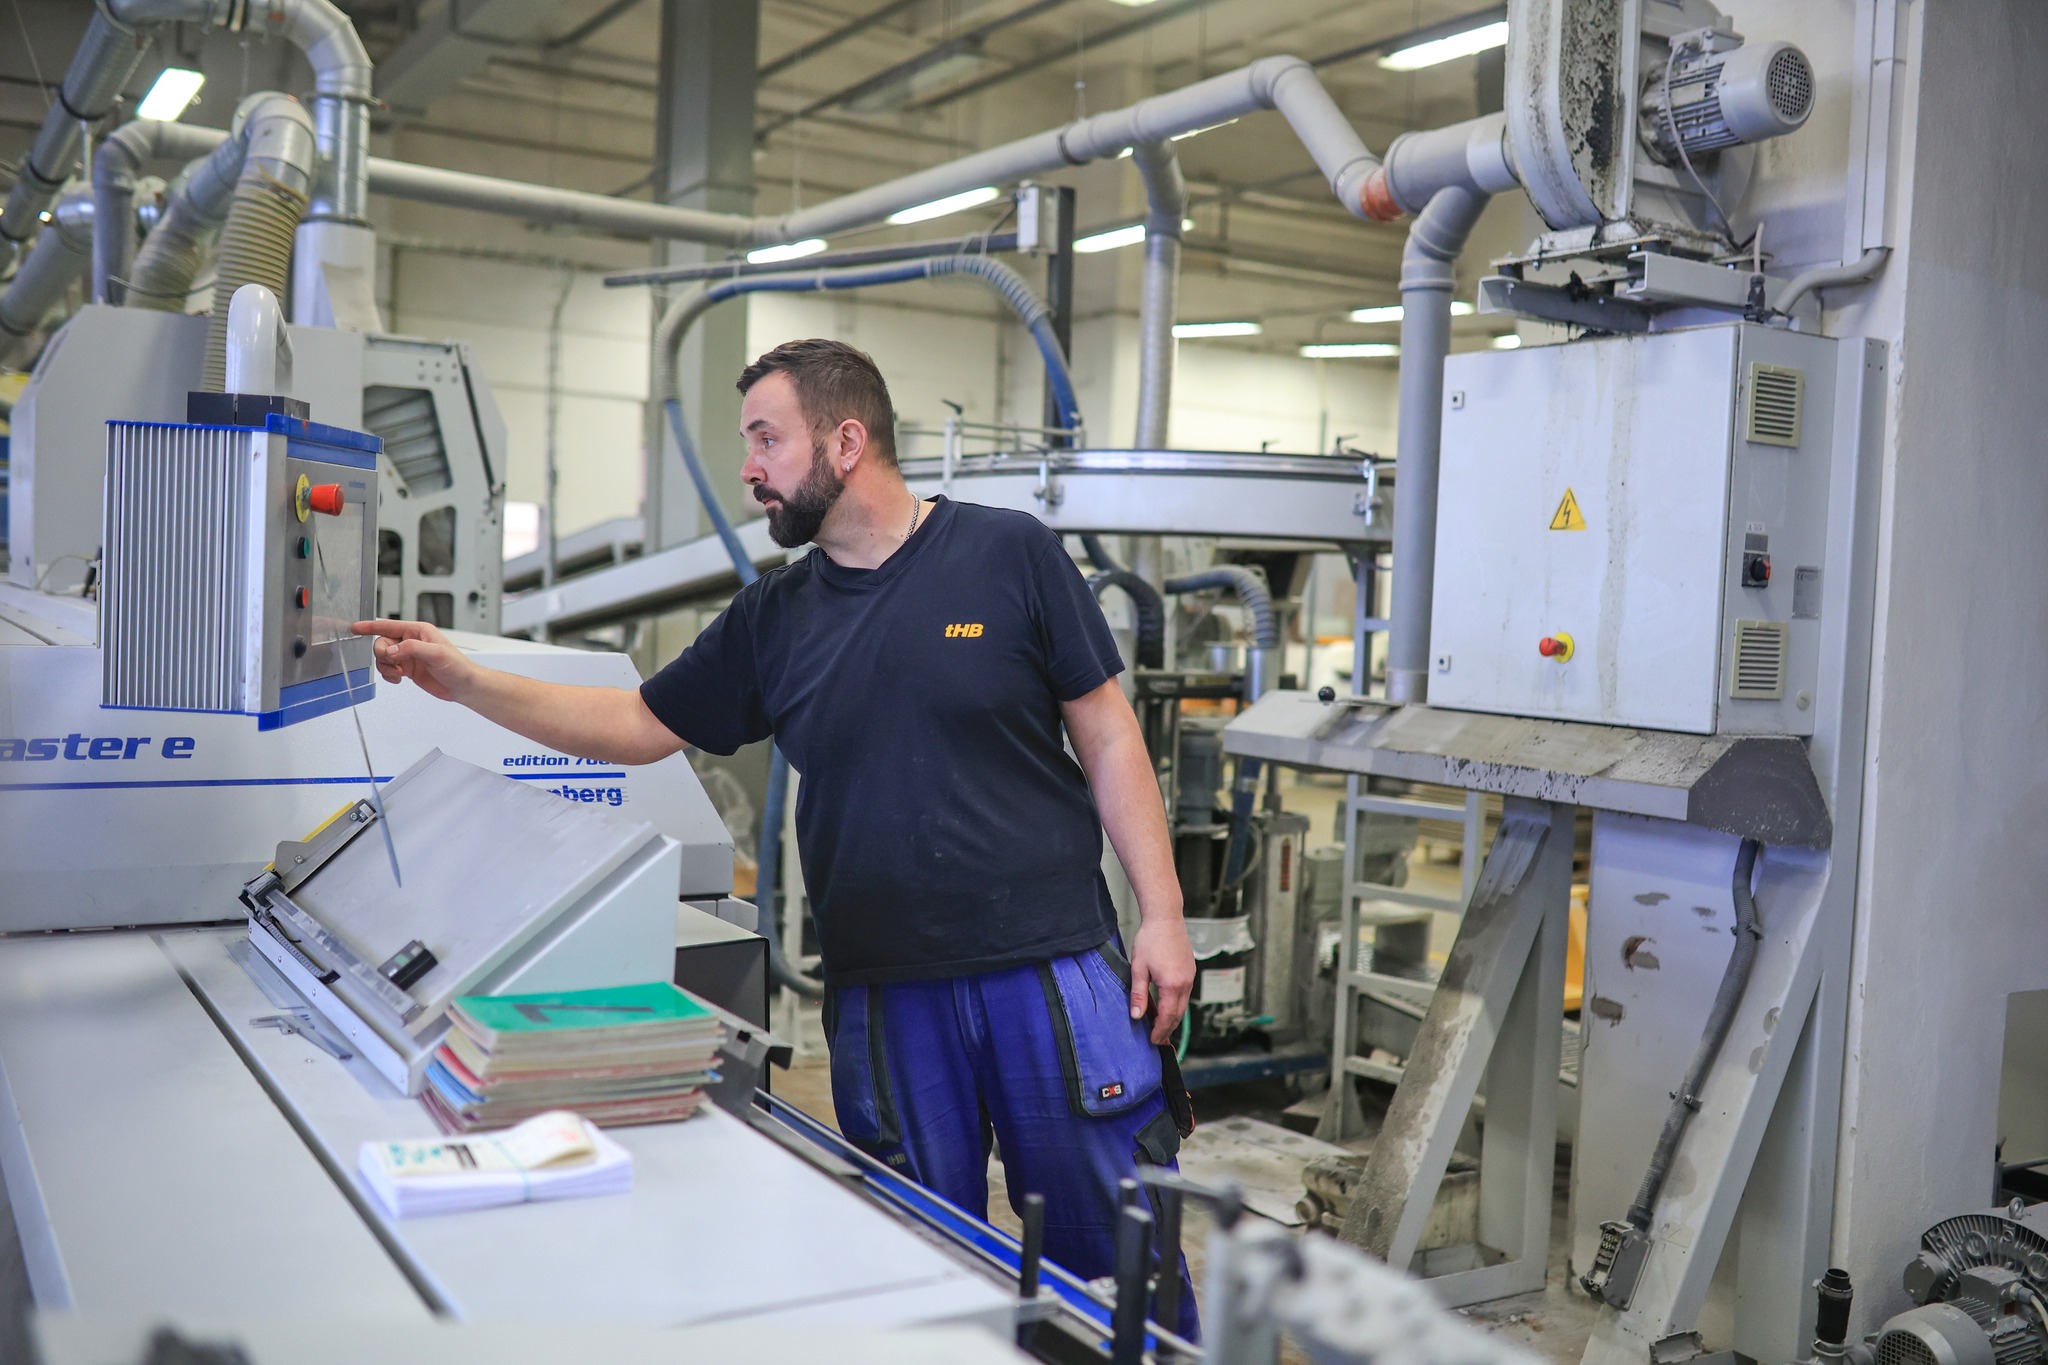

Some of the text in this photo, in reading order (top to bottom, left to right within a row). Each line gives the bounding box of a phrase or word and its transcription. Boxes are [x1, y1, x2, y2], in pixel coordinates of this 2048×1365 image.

[944, 623, 984, 638] tHB
[161, 736, 195, 759] e
[502, 754, 569, 766] edition
